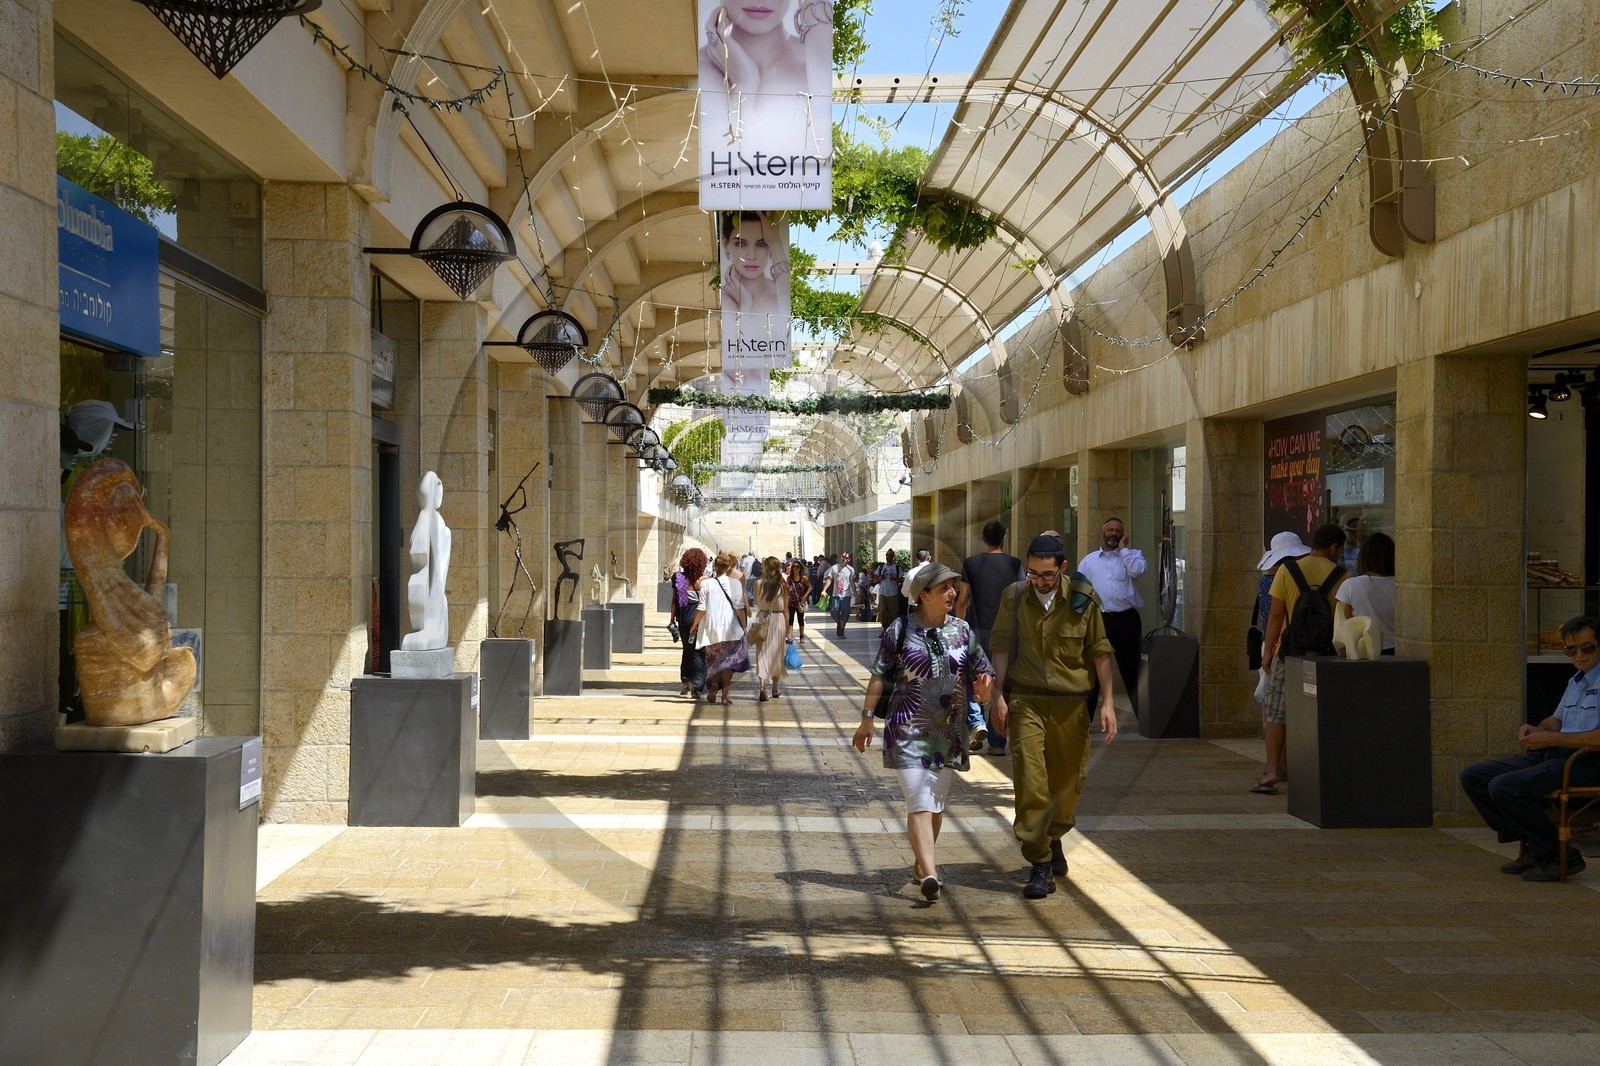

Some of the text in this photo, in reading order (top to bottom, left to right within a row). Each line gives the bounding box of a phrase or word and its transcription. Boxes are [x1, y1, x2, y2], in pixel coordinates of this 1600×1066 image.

[778, 181, 801, 189] הולמס
[58, 190, 113, 251] olumbia
[73, 288, 112, 328] קולומביה
[1270, 430, 1320, 457] HOW CAN WE
[1270, 453, 1320, 484] make your day
